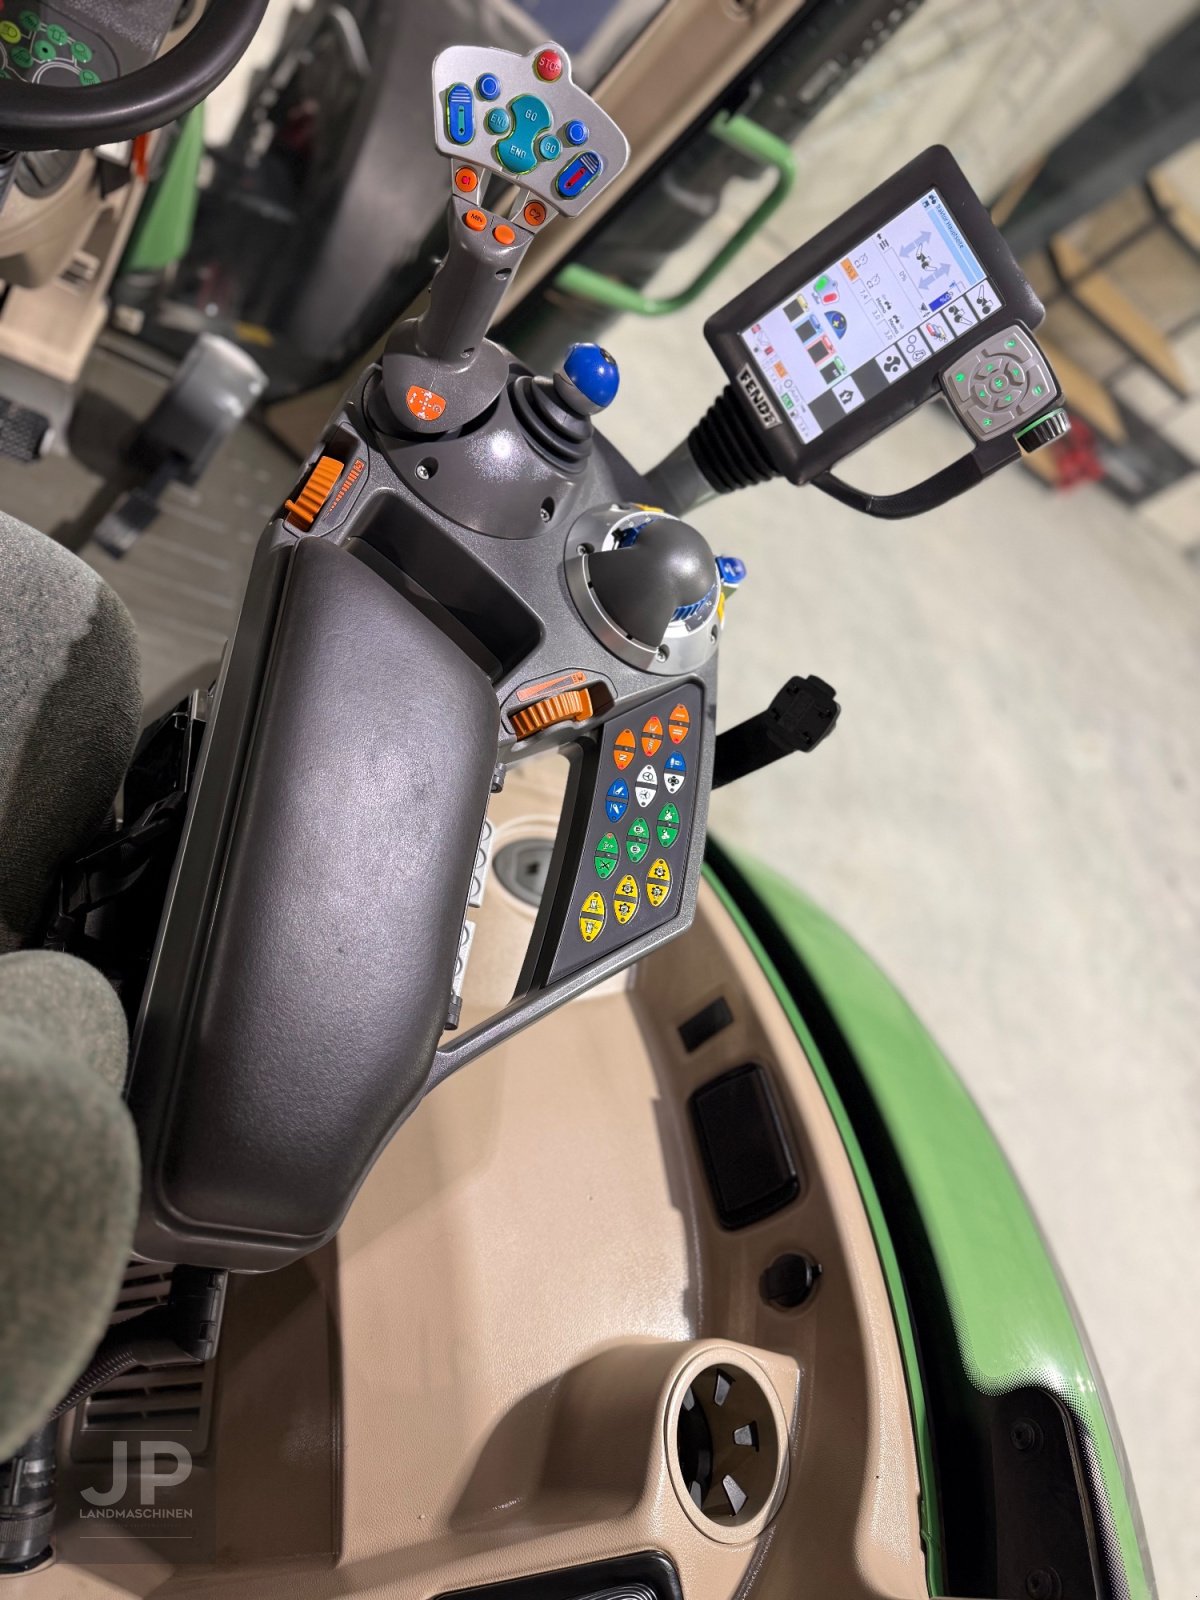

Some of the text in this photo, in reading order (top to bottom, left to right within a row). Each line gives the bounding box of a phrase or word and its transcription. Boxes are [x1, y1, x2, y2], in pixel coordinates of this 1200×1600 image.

[539, 57, 560, 72] STOP
[490, 114, 507, 127] END
[525, 110, 537, 122] GO
[509, 145, 527, 159] END
[544, 141, 556, 154] GO
[529, 208, 541, 221] C2
[944, 220, 964, 249] Hauptseite
[737, 368, 777, 427] FENDT
